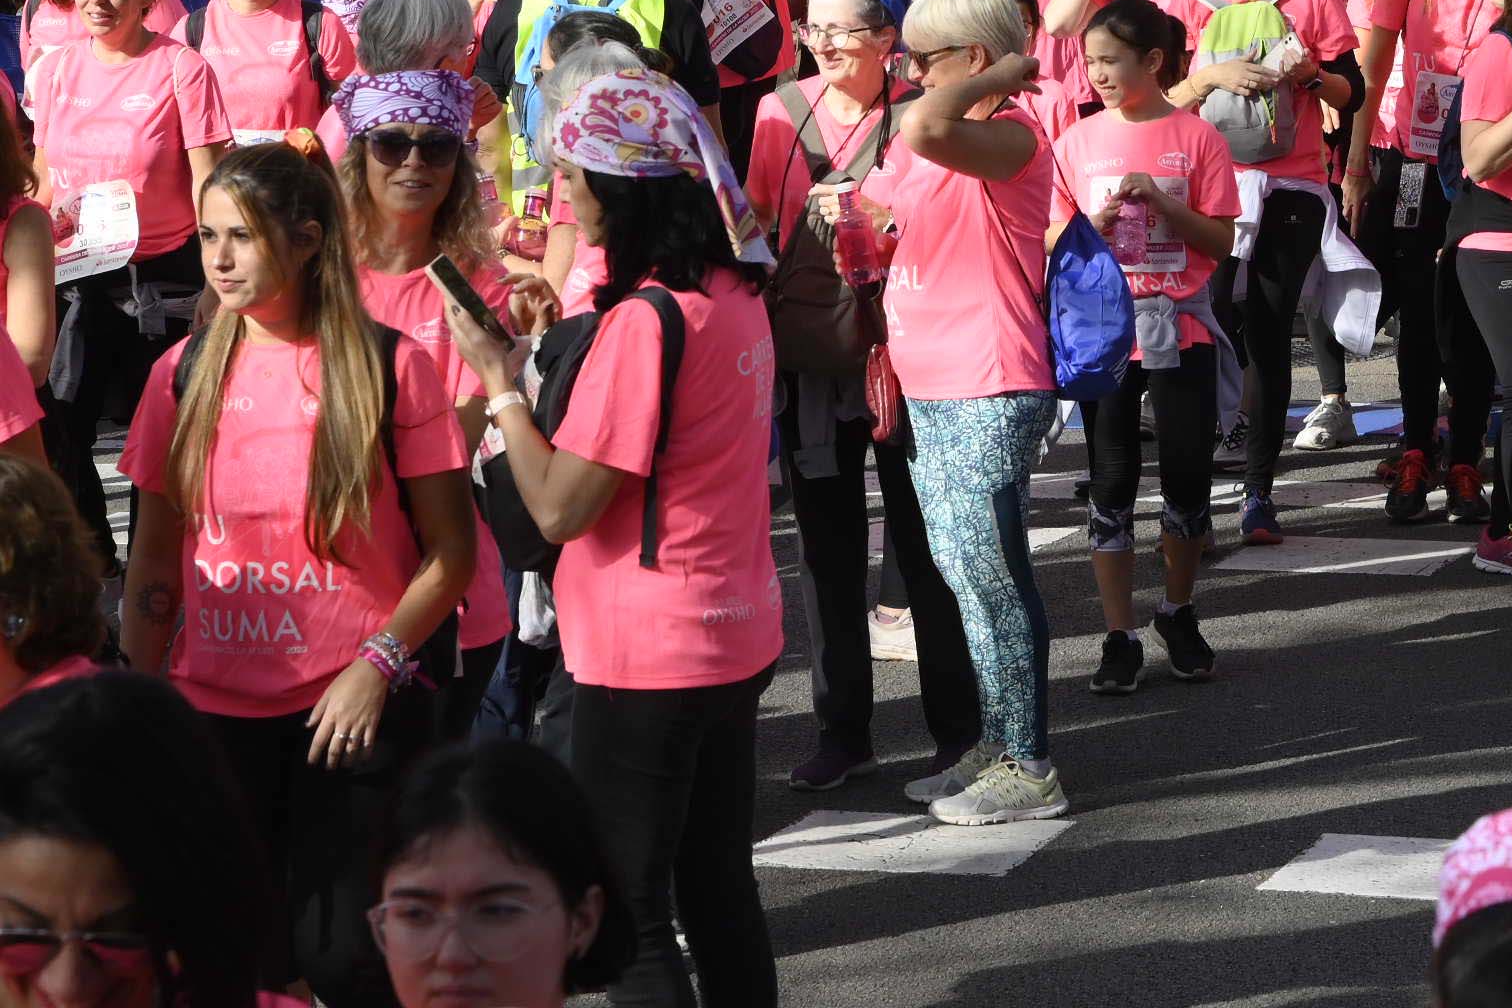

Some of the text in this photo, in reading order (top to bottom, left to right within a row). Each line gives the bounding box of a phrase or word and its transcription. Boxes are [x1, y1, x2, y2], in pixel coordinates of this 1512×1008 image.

[1413, 53, 1434, 72] TU
[888, 265, 923, 291] SAL
[194, 560, 342, 593] DORSAL
[200, 608, 303, 642] SUMA
